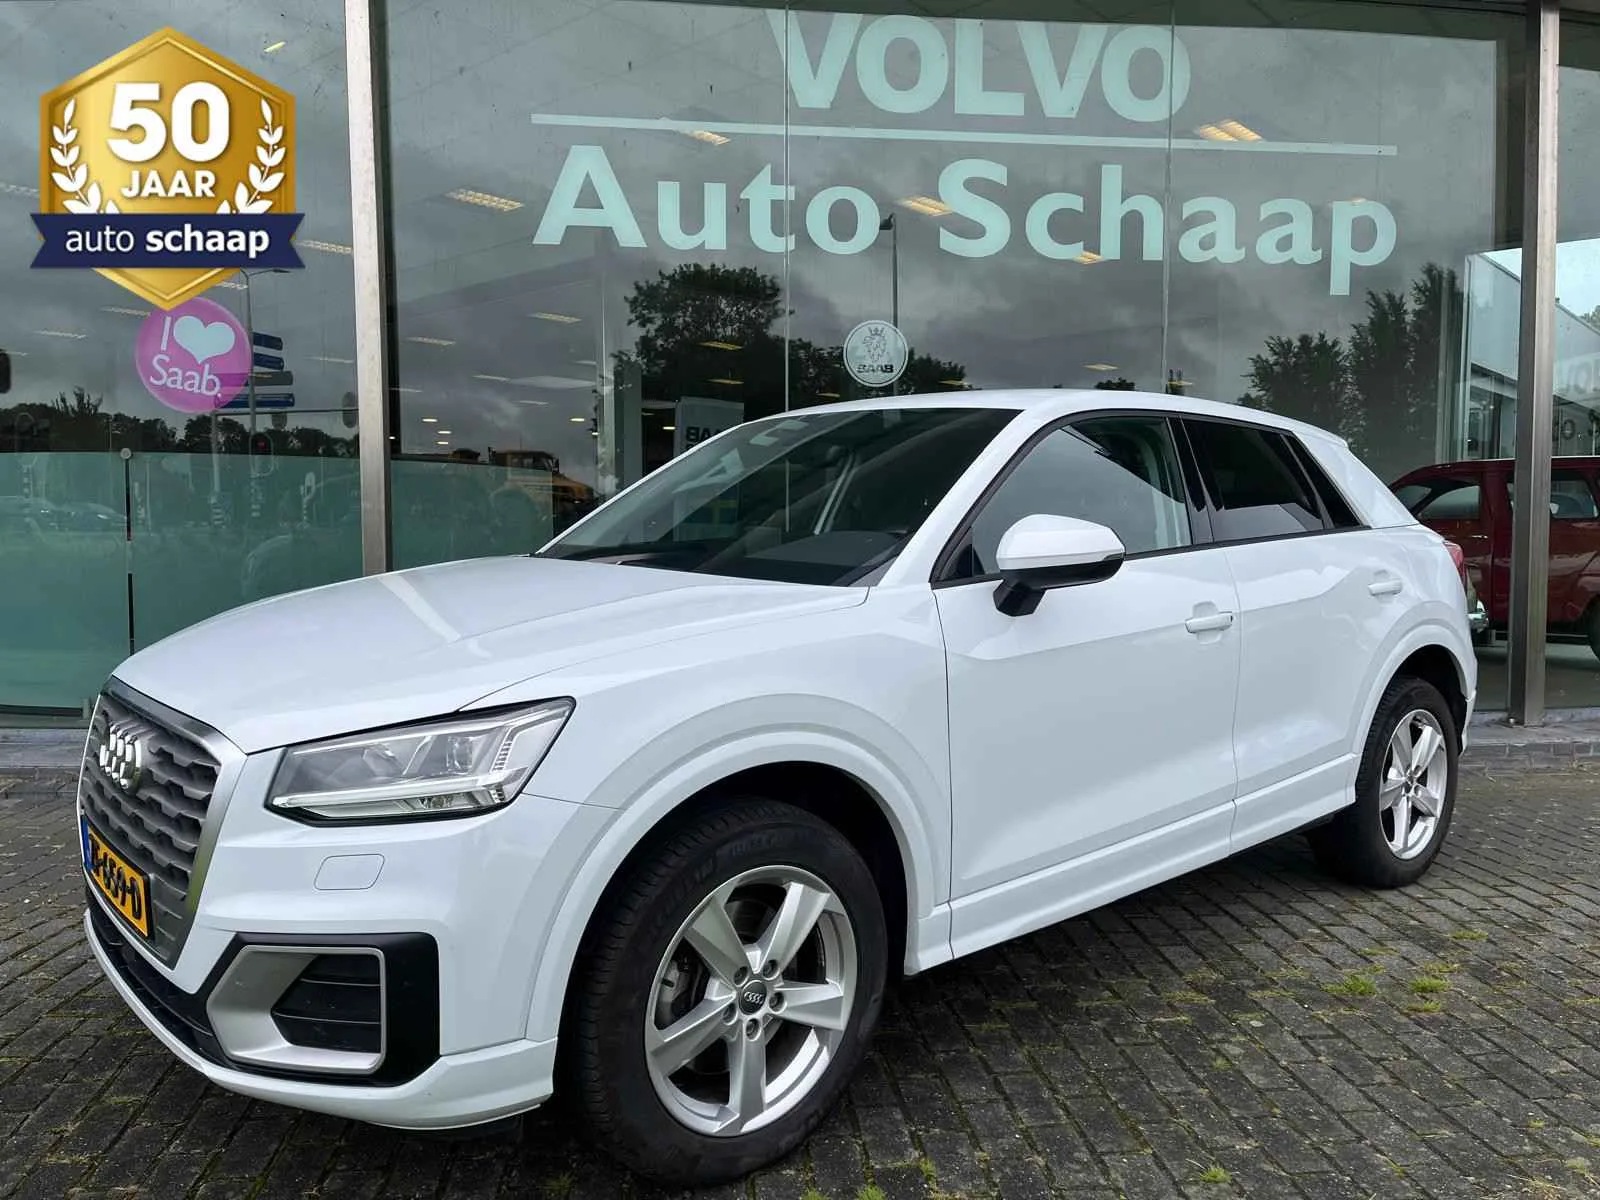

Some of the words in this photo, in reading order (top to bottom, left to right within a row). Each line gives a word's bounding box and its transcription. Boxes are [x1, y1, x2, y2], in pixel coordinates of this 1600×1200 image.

[767, 10, 1191, 123] VOLVO
[532, 145, 880, 255] Auto
[937, 158, 1397, 296] Schaap
